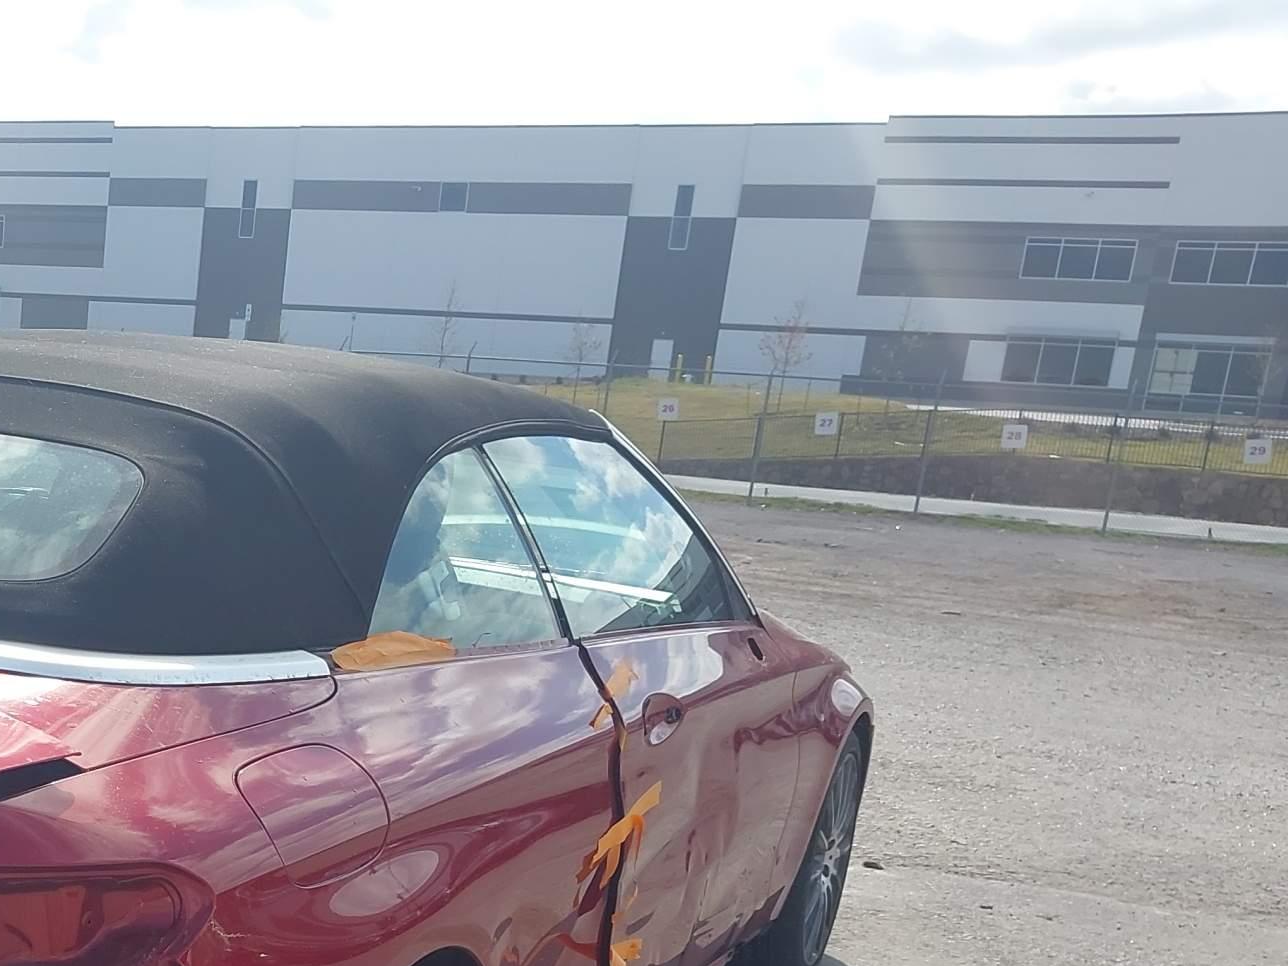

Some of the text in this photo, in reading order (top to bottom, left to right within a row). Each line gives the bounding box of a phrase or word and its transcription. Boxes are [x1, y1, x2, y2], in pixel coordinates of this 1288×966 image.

[819, 418, 834, 428] 27
[1006, 431, 1022, 441] 28
[1249, 446, 1266, 456] 29
